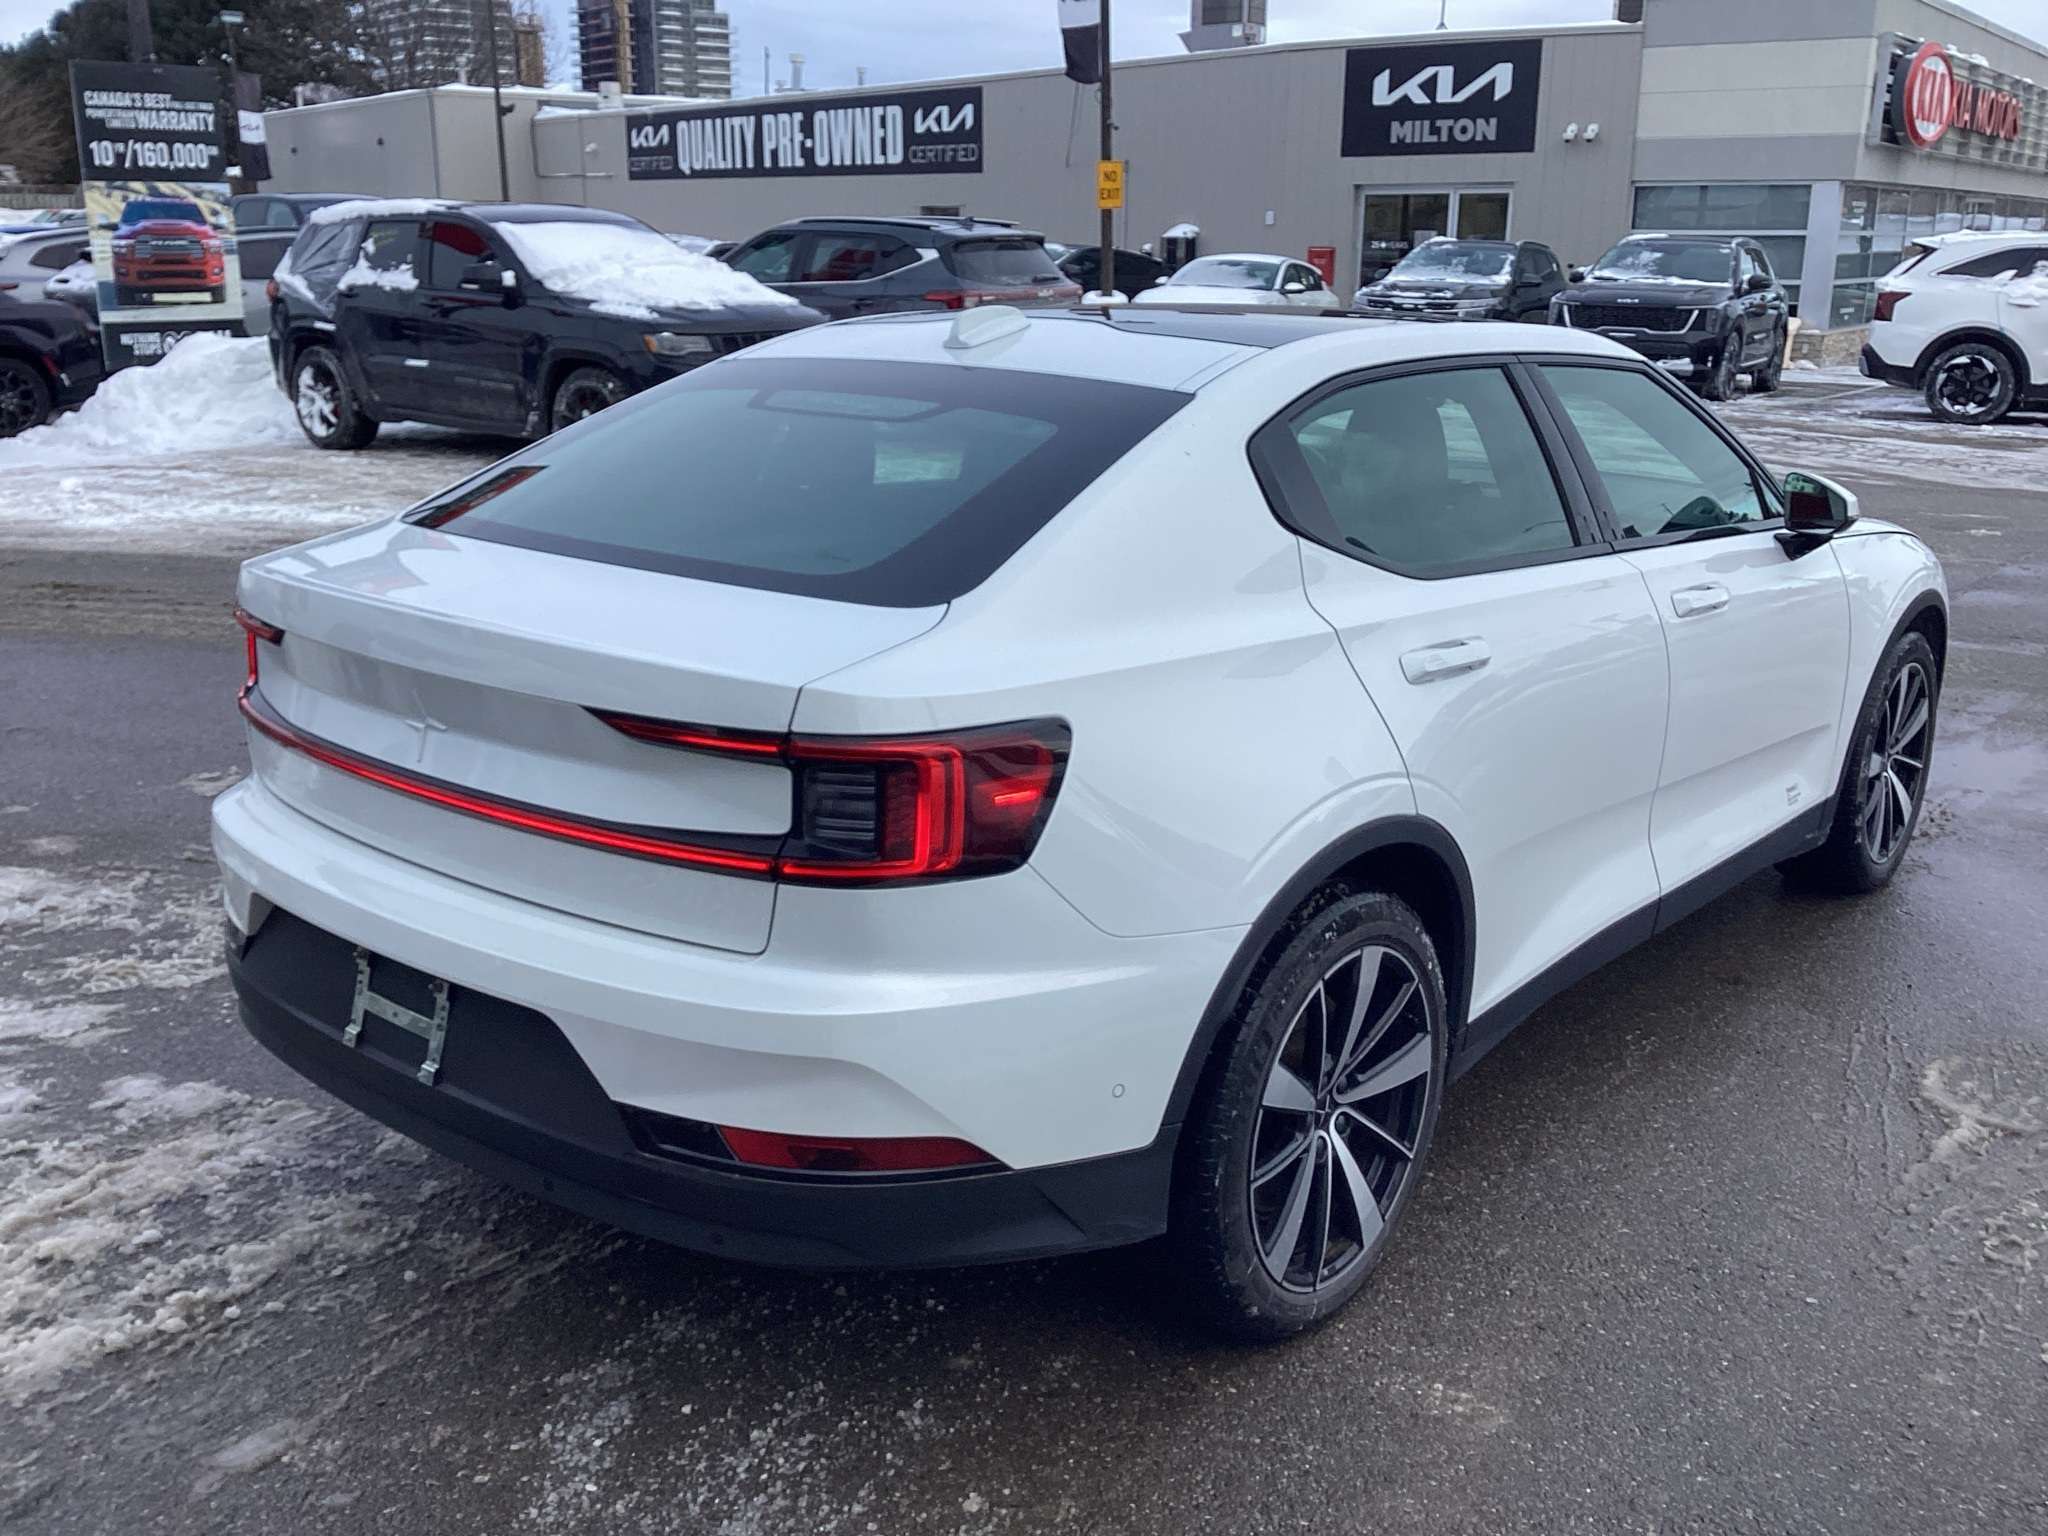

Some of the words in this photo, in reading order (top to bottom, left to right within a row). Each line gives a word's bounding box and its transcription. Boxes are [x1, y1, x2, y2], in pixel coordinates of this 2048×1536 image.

[1372, 62, 1514, 106] KIA
[1914, 66, 1948, 125] KIA
[83, 91, 142, 107] CANADA'S
[143, 93, 172, 109] BEST
[134, 110, 215, 132] WARRANTY
[914, 103, 975, 133] KIA
[1390, 117, 1498, 144] MILTON
[631, 123, 670, 148] KIA
[676, 115, 756, 175] QUALITY
[761, 104, 904, 168] PRE-OWNED
[908, 143, 979, 163] CERTIFIED
[1103, 170, 1117, 182] NO
[1101, 188, 1121, 200] EXIT
